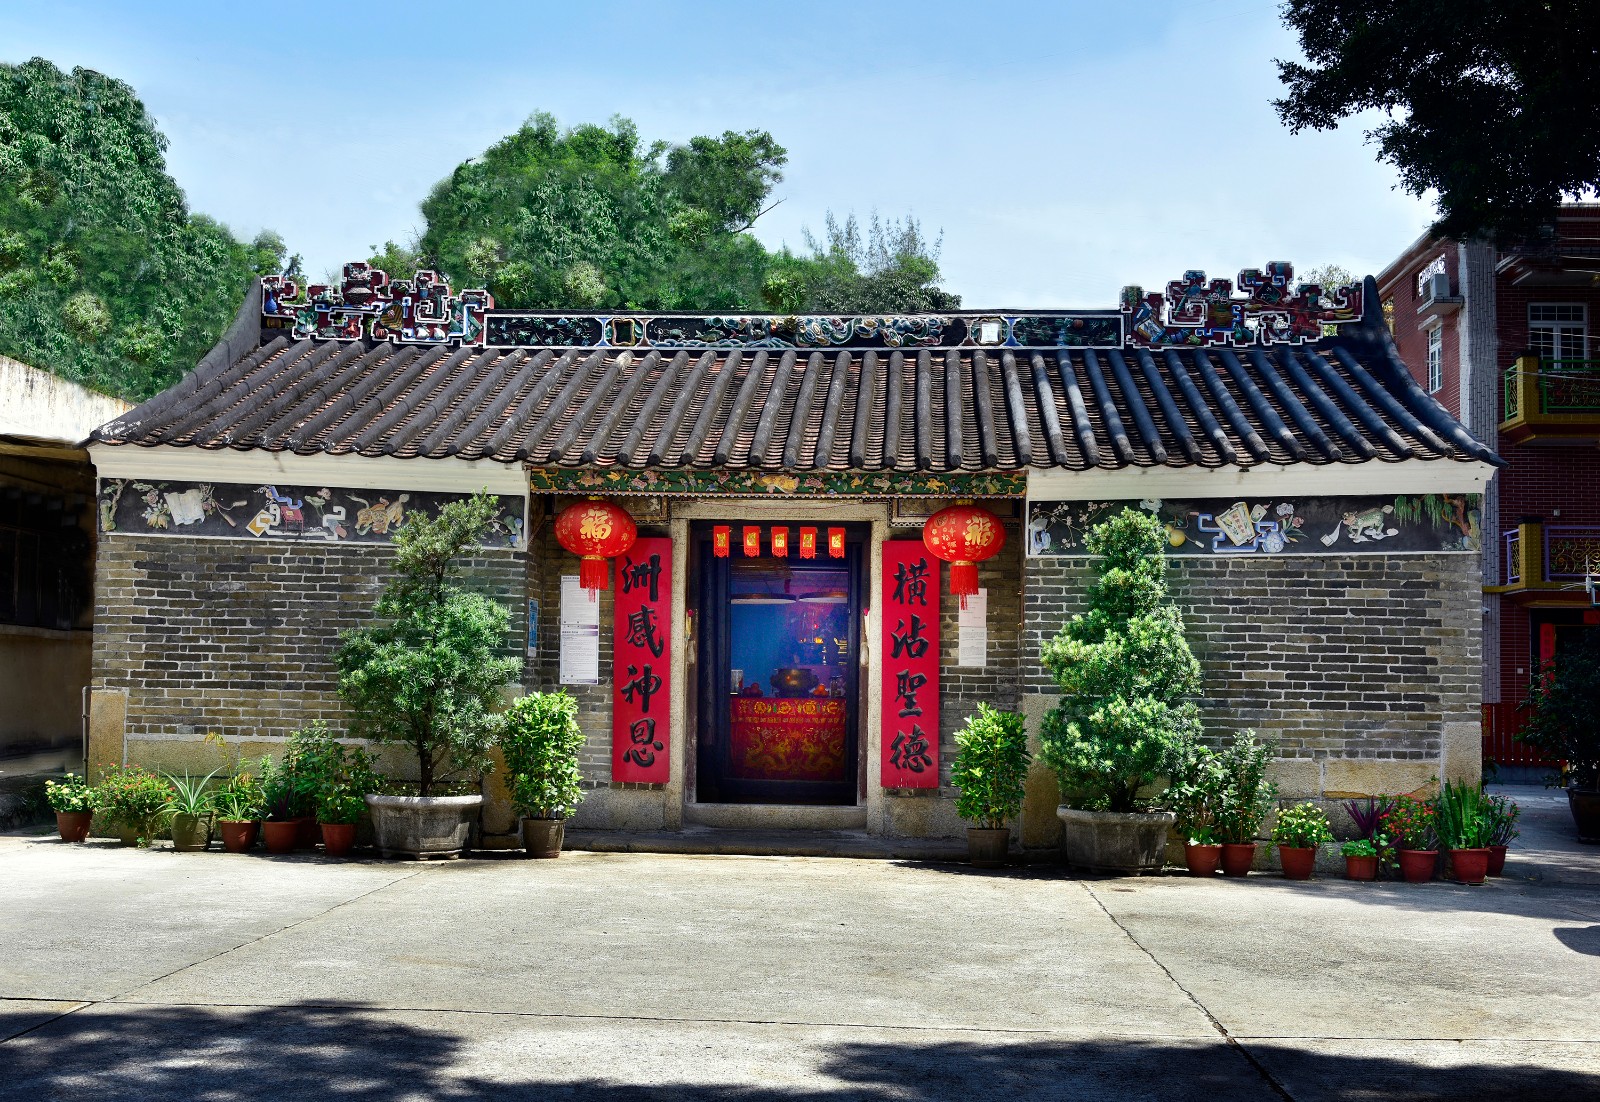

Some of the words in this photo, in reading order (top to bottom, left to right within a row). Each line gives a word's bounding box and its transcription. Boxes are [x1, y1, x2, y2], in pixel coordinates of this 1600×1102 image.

[580, 508, 612, 539] 福
[965, 514, 995, 546] 福
[621, 553, 664, 768] 洲感神恩
